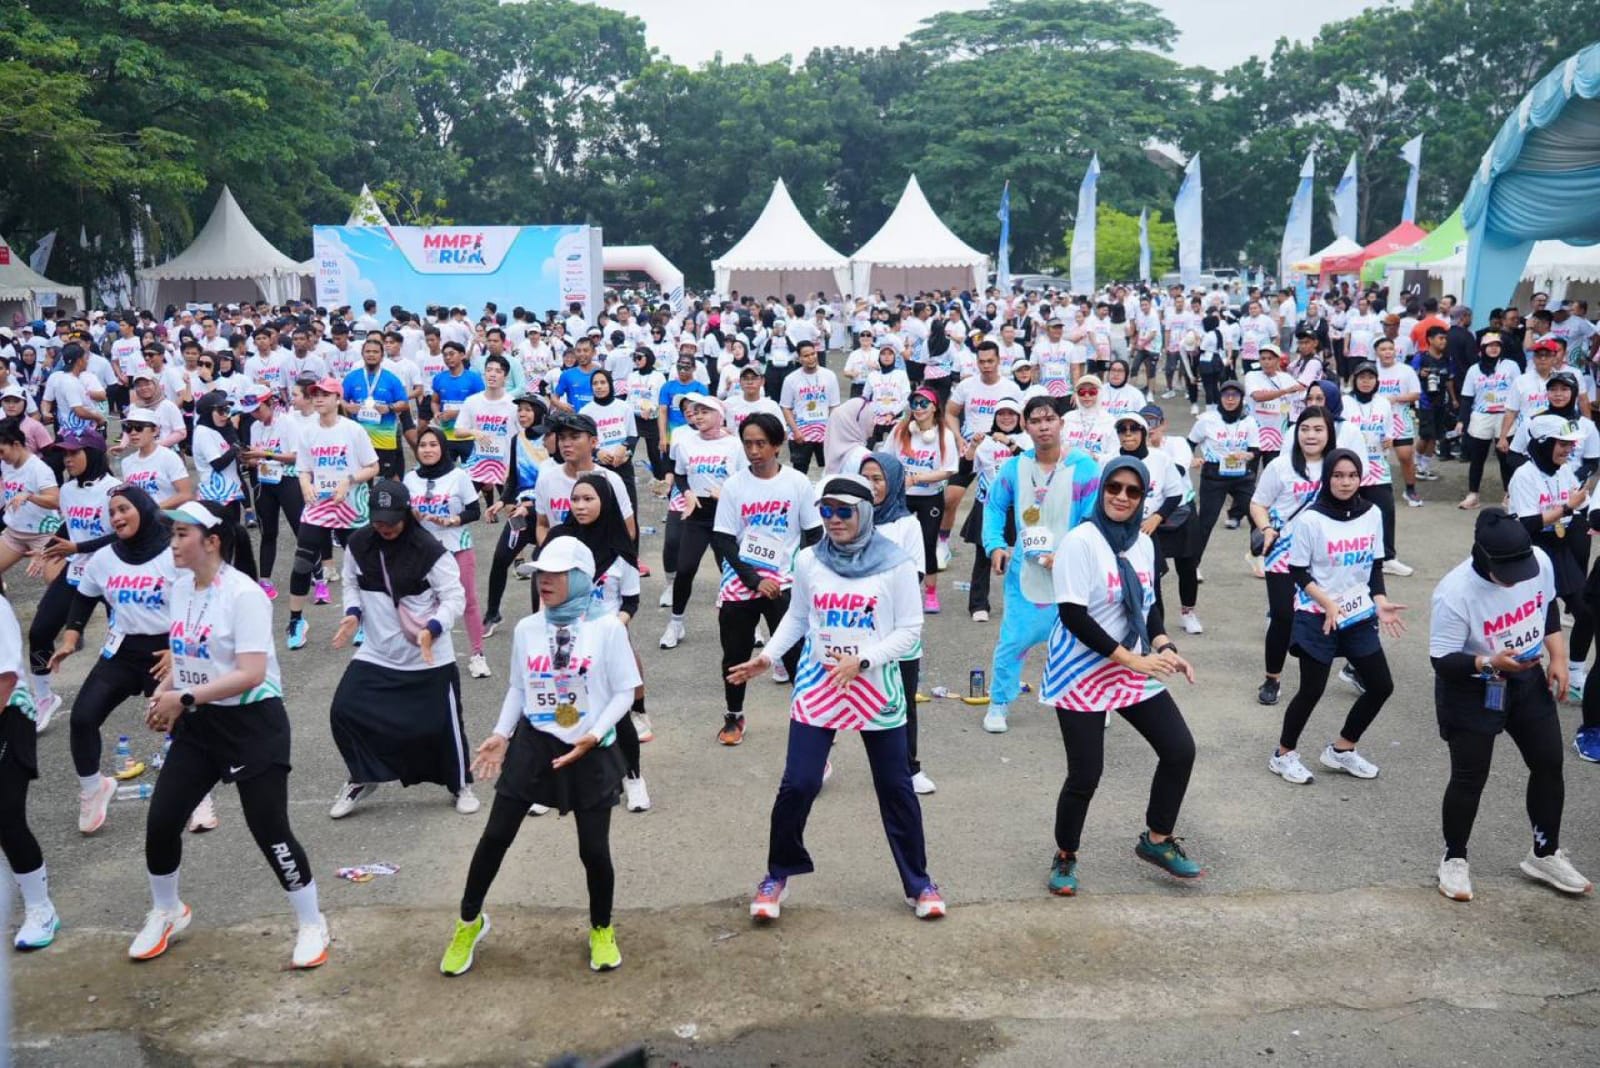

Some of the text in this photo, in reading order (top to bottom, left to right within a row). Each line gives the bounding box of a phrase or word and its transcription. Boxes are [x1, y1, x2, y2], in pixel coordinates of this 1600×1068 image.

[439, 250, 486, 266] RUN
[317, 456, 348, 467] RUN
[697, 464, 728, 475] RUN
[741, 500, 791, 516] MMPI
[70, 518, 105, 533] RUN
[748, 514, 789, 528] RUN
[746, 543, 776, 560] 5038
[118, 590, 165, 606] RUN
[813, 593, 878, 615] MMPI
[827, 610, 875, 631] RUN
[1504, 626, 1540, 650] 5446
[179, 670, 209, 685] 5108
[537, 692, 577, 706] 559
